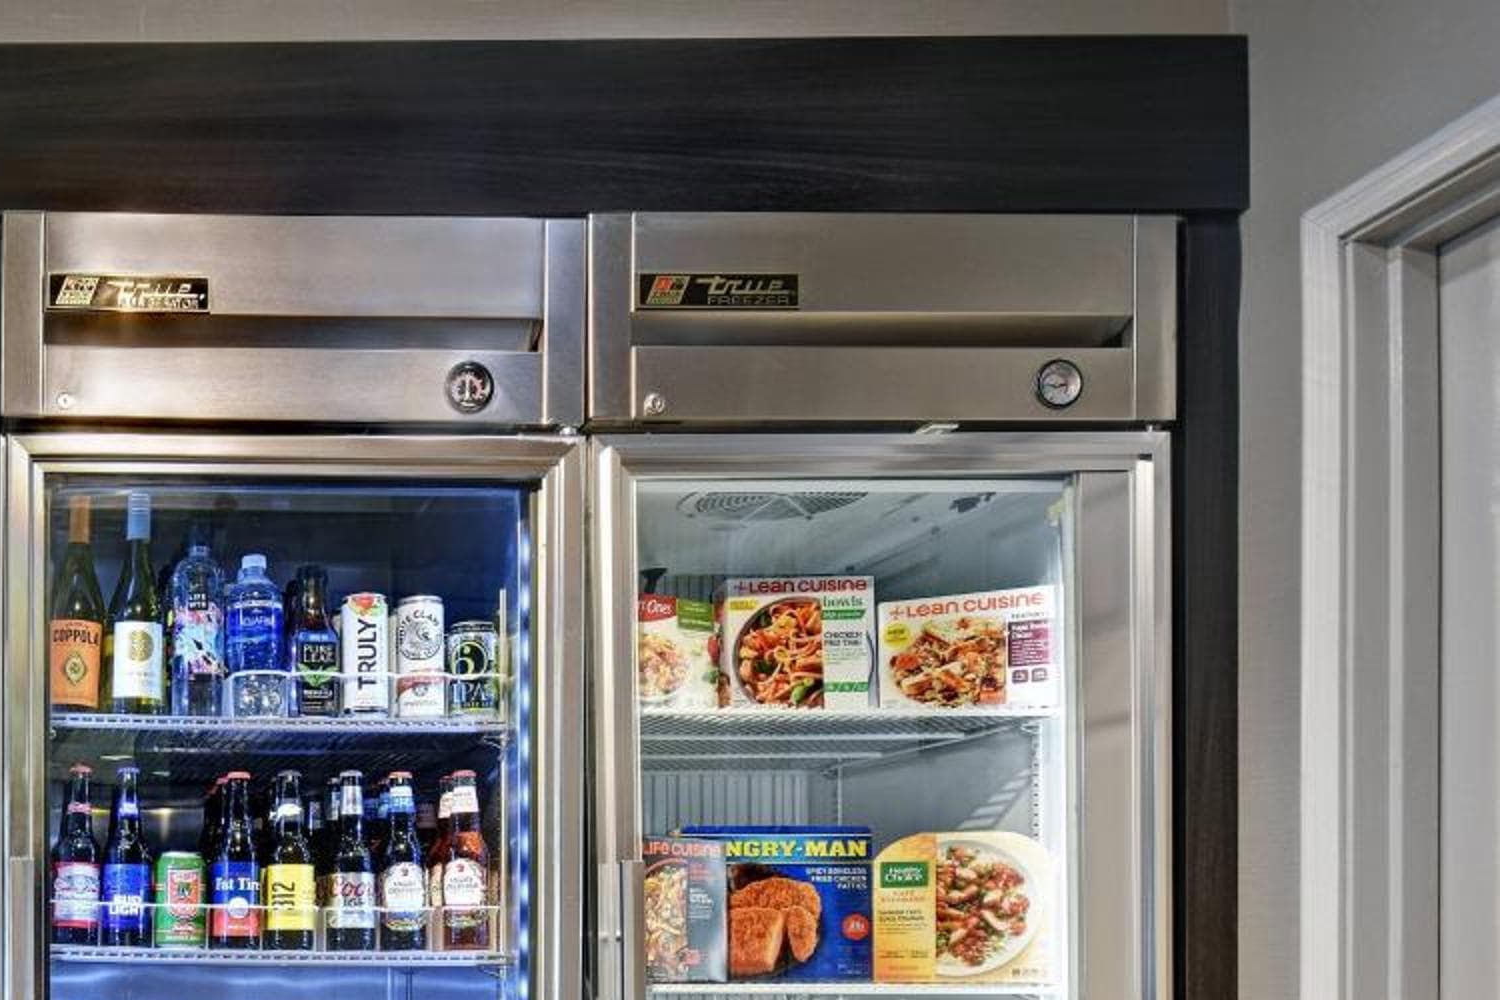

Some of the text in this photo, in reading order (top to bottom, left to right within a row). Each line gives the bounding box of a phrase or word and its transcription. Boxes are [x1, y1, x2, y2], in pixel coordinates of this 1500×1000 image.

[52, 628, 100, 646] COPPOLA
[357, 618, 378, 692] TRULY
[726, 840, 868, 857] NGRY-MAN
[215, 877, 235, 891] Fat
[270, 881, 296, 911] 312
